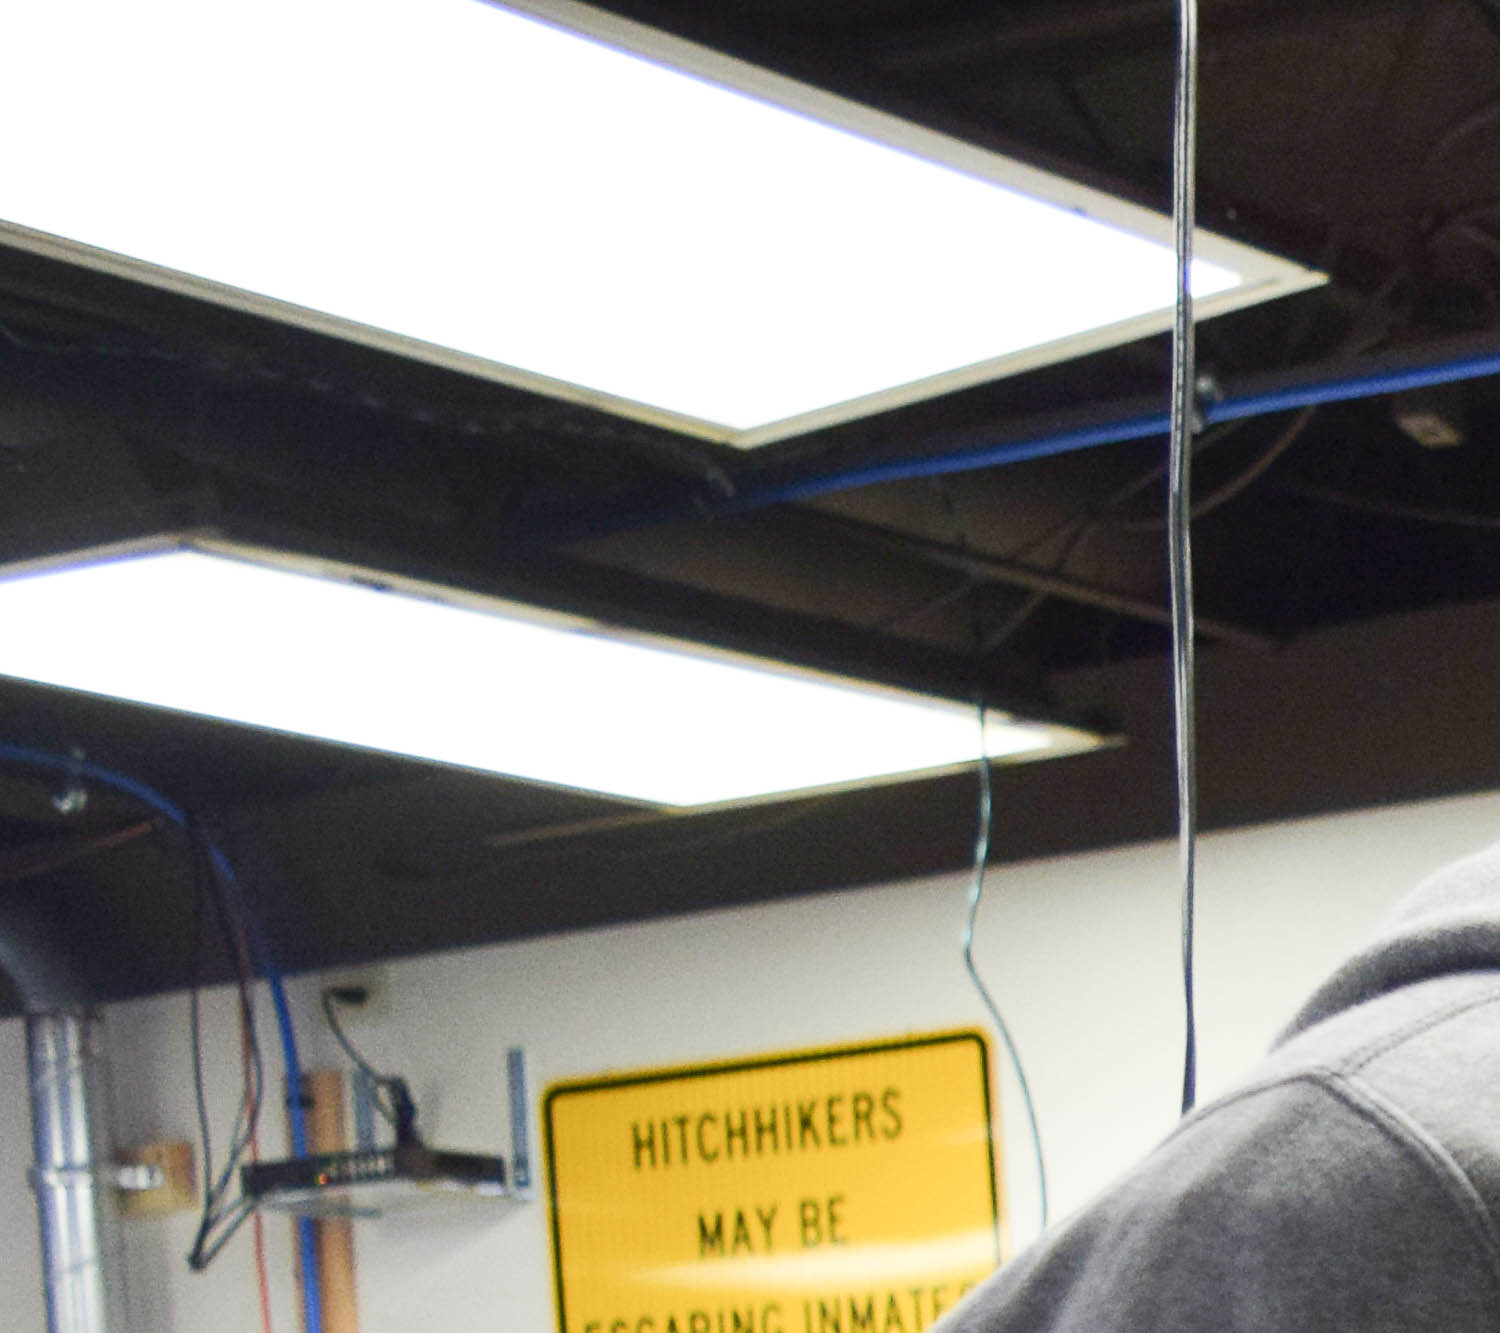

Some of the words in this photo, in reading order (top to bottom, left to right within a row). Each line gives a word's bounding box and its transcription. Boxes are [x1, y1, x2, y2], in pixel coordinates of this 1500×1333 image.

[631, 1088, 903, 1171] HITCHHIKERS
[697, 1203, 778, 1257] MAY
[799, 1195, 847, 1248] BE
